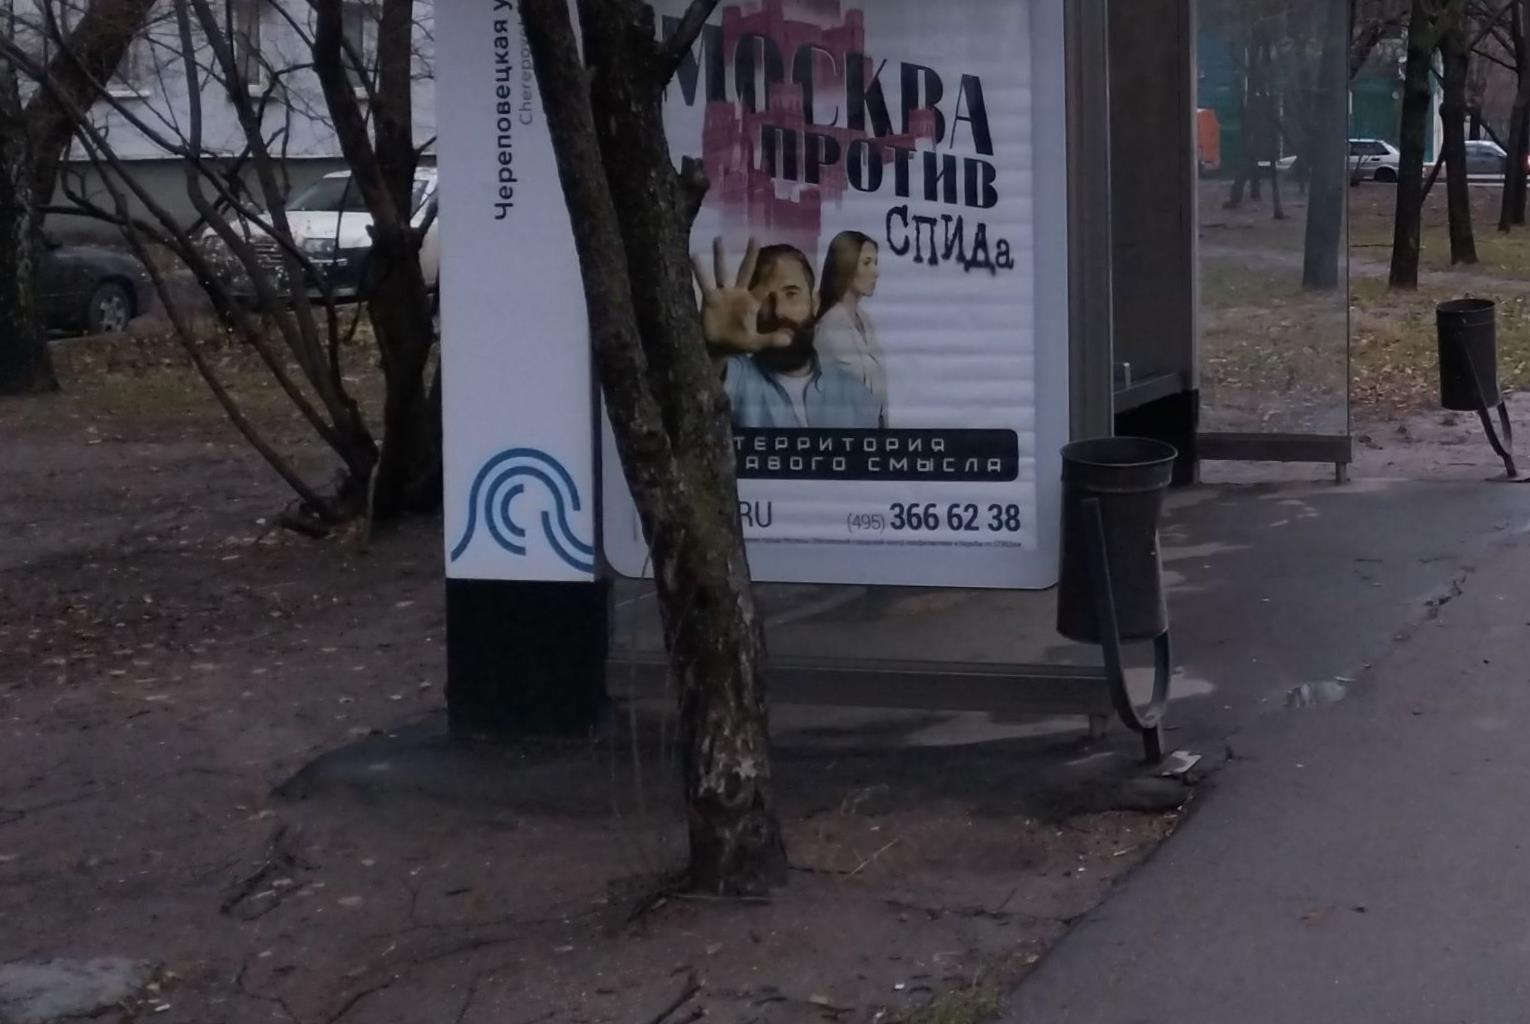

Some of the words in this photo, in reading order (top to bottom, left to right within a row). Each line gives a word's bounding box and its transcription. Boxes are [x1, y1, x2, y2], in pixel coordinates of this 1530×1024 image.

[493, 20, 517, 220] Череповецкая
[760, 124, 998, 209] ПРОТИВ
[733, 437, 945, 452] ТЕРРИТОРИЯ
[745, 456, 846, 471] АВОГО
[868, 457, 1001, 473] СМЫСЛА
[846, 513, 885, 534] (495)
[889, 502, 940, 531] 366
[946, 503, 979, 531] 62
[987, 503, 1021, 532] 38
